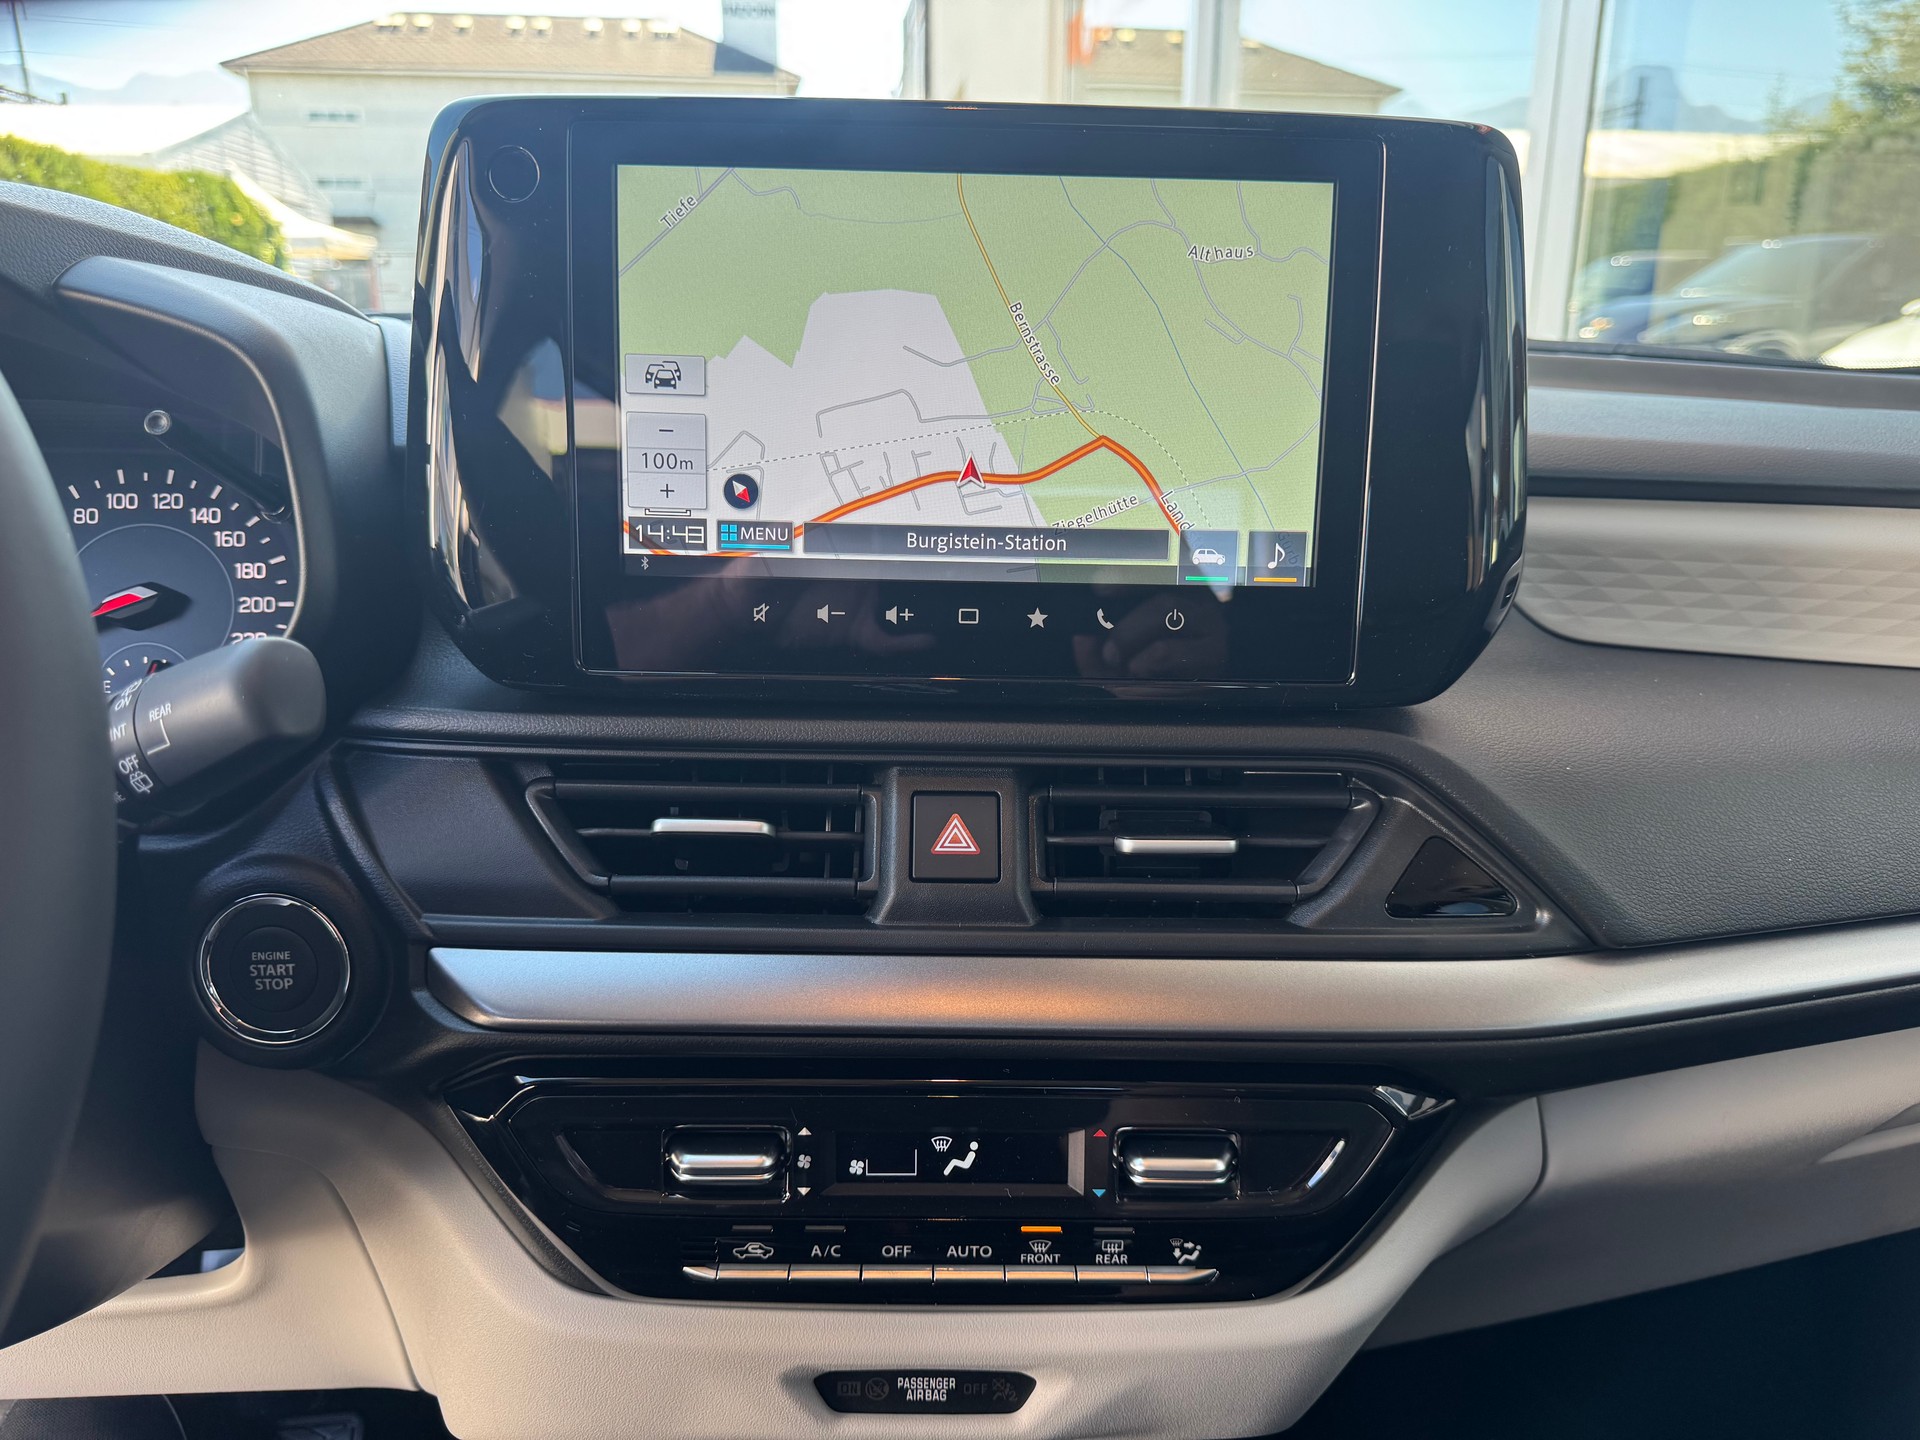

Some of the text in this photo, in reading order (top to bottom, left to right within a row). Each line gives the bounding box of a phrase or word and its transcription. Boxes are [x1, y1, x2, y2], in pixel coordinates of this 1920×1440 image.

[660, 195, 697, 228] Tiefe
[1187, 244, 1255, 262] Althaus
[1009, 301, 1061, 385] Bernstrasse
[106, 493, 139, 510] 100
[152, 493, 184, 510] 120
[73, 508, 99, 524] 80
[190, 507, 222, 524] 140
[214, 531, 246, 547] 160
[635, 524, 705, 544] 14:43
[740, 526, 789, 542] MENU
[906, 531, 1068, 553] Burgistein-Station
[234, 562, 267, 579] 180
[238, 597, 276, 613] 200
[149, 703, 172, 722] REAR
[109, 723, 127, 742] INT
[119, 754, 140, 774] OFF
[251, 951, 291, 961] ENGINE
[249, 963, 296, 977] START
[255, 978, 294, 990] STOP
[811, 1244, 842, 1258] A/C
[882, 1245, 912, 1258] OFF
[946, 1245, 992, 1258] AUTO
[1020, 1253, 1061, 1264] FRONT
[1095, 1254, 1128, 1265] REAR
[897, 1377, 956, 1389] PASSENGER
[906, 1389, 947, 1401] AIRBAG
